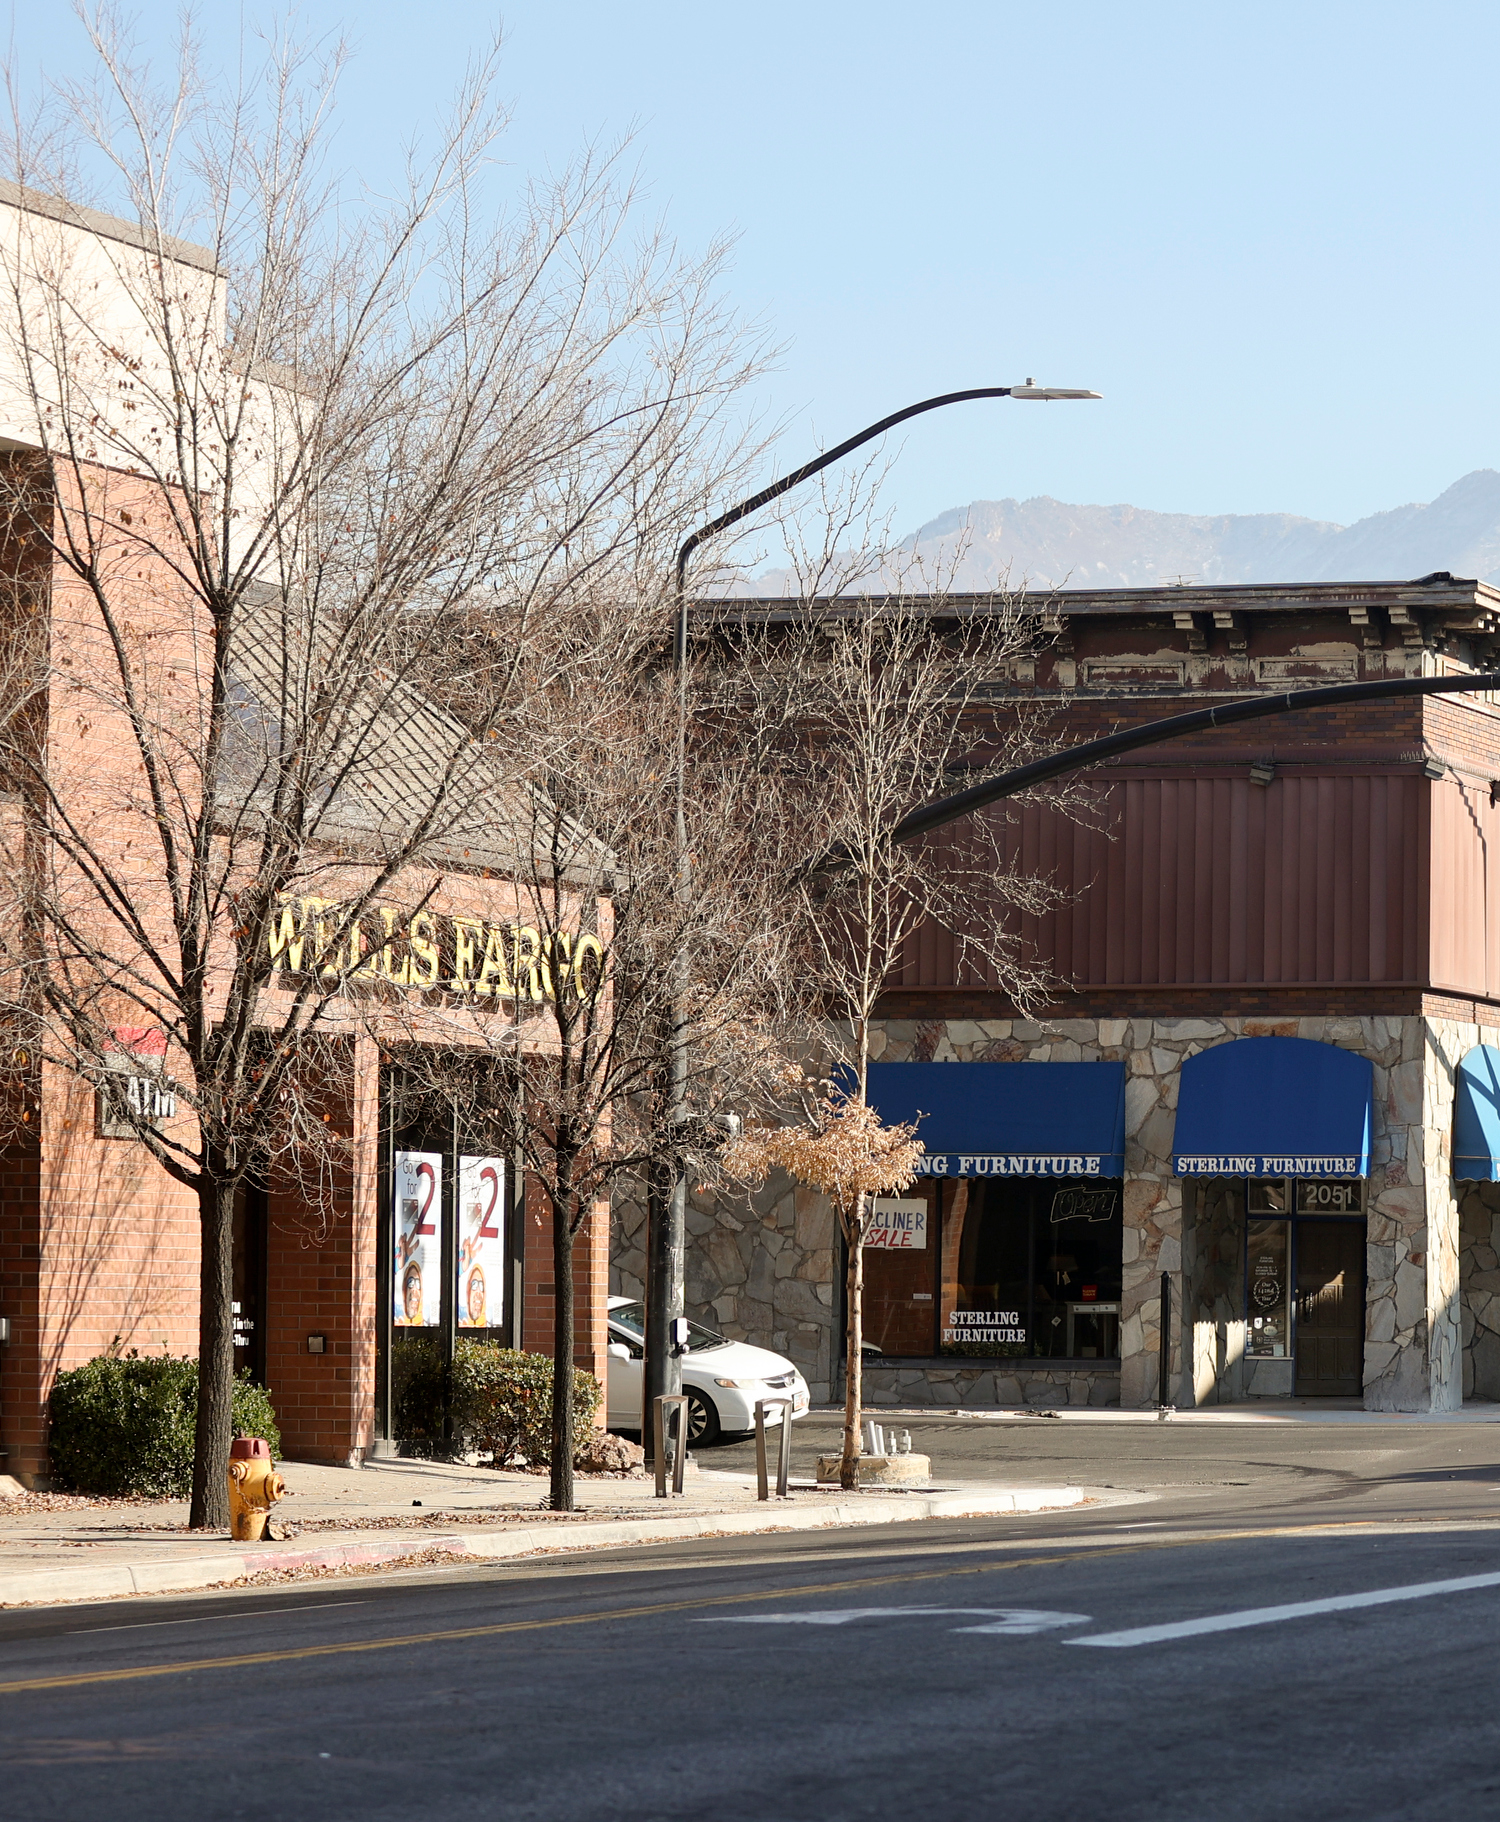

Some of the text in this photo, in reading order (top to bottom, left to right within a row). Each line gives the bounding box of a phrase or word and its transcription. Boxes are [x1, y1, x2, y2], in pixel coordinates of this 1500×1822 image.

[268, 892, 605, 1004] WELLS FARGO
[127, 1075, 176, 1118] ATM
[402, 1158, 413, 1174] Go
[958, 1156, 1100, 1174] FURNITURE
[1177, 1157, 1356, 1173] STERLING FURNITURE
[407, 1179, 418, 1195] for
[1306, 1185, 1352, 1204] 2051
[416, 1161, 436, 1235] 2
[480, 1166, 499, 1239] 2
[864, 1230, 913, 1248] SALE
[949, 1311, 1019, 1325] STERLING
[943, 1328, 1026, 1343] FURNITURE
